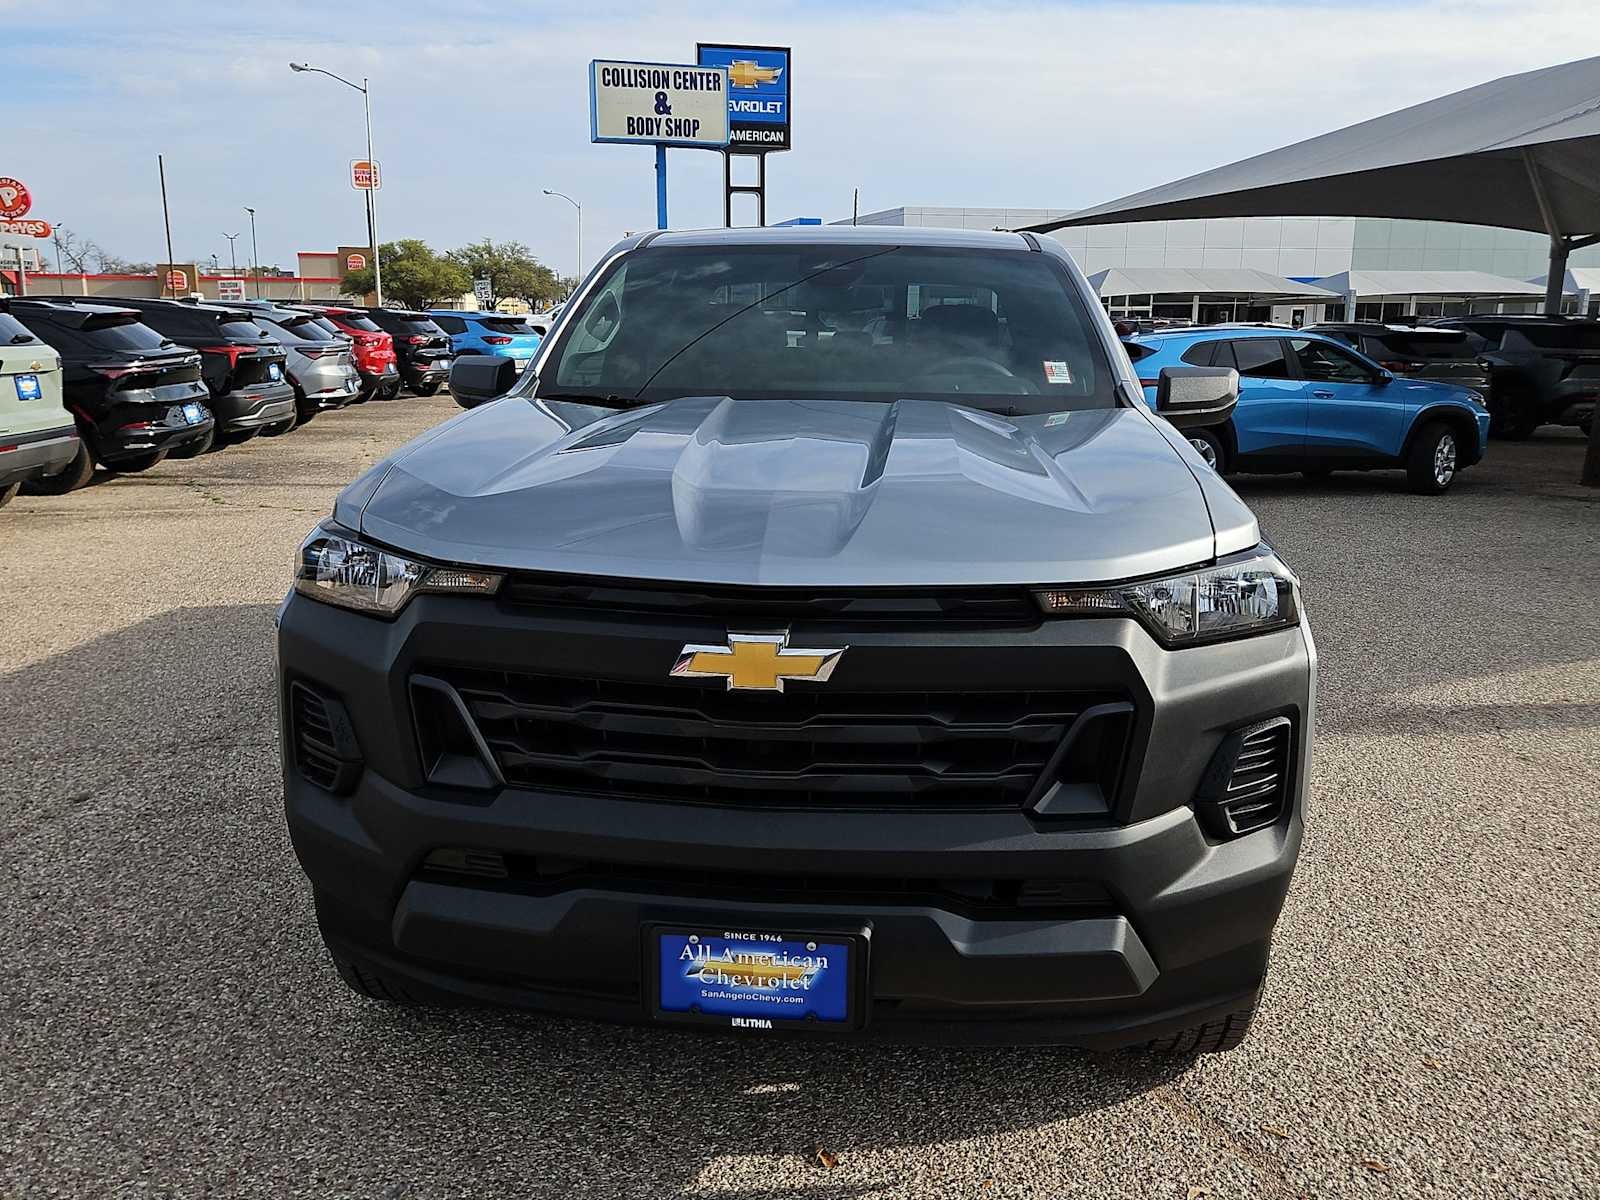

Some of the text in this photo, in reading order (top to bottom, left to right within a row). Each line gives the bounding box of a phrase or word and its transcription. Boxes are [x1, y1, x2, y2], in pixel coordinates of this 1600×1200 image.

[602, 67, 721, 91] COLLISION CENTER
[654, 91, 672, 115] &
[729, 100, 783, 114] EVROLET
[627, 116, 700, 137] BODY SHOP
[729, 131, 784, 143] AMERICAN
[723, 931, 783, 943] SINCE 1946
[679, 944, 829, 969] All American
[698, 967, 811, 990] Chevrolet
[701, 989, 804, 1004] SanAngeloChevy.com
[740, 1018, 773, 1029] LITHIA
